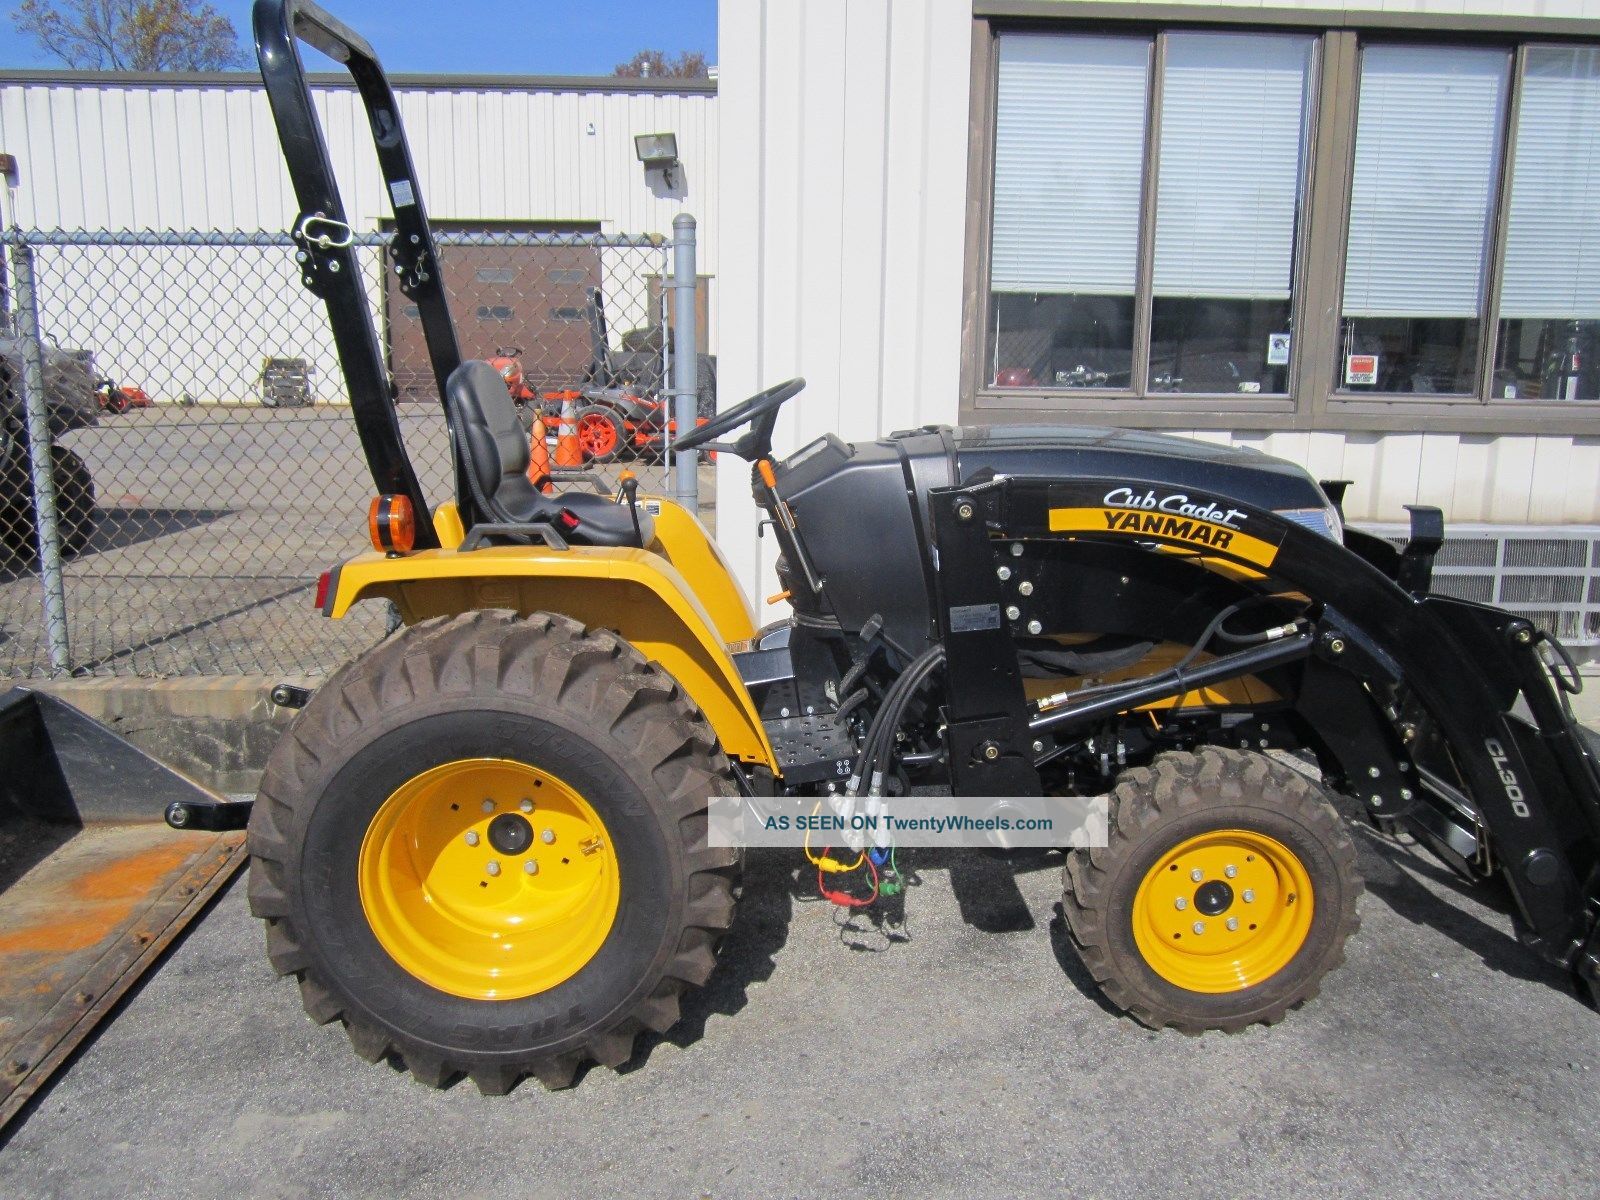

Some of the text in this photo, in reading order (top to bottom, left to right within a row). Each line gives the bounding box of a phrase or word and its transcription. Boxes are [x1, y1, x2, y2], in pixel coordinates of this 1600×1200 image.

[1103, 487, 1248, 530] Cub Cadet
[1103, 510, 1234, 549] YANMAR
[1484, 738, 1531, 818] CL300
